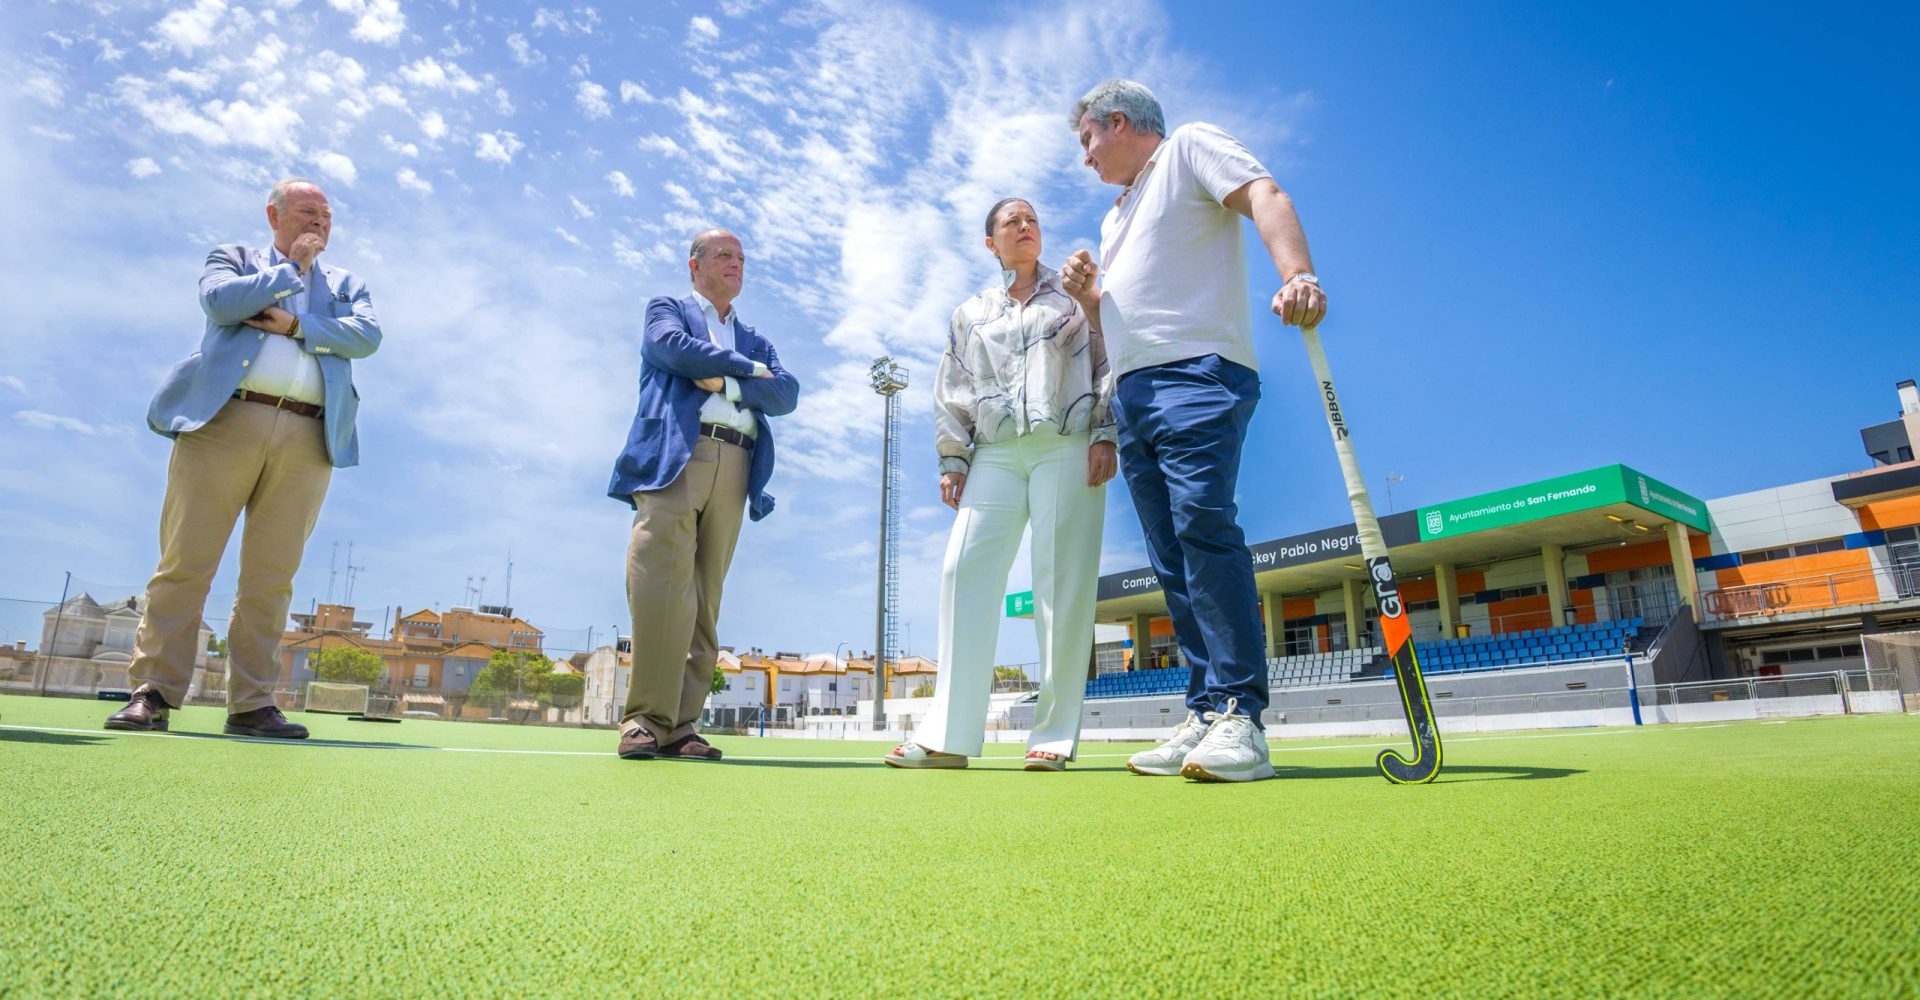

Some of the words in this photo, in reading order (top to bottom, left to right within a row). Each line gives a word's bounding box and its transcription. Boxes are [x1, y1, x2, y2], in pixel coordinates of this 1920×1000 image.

[1449, 503, 1511, 523] Ayuntamiento
[1513, 499, 1525, 509] de
[1527, 495, 1546, 505] San
[1547, 485, 1596, 501] Fernando
[1122, 575, 1158, 589] Campo
[1280, 542, 1317, 559] Pablo
